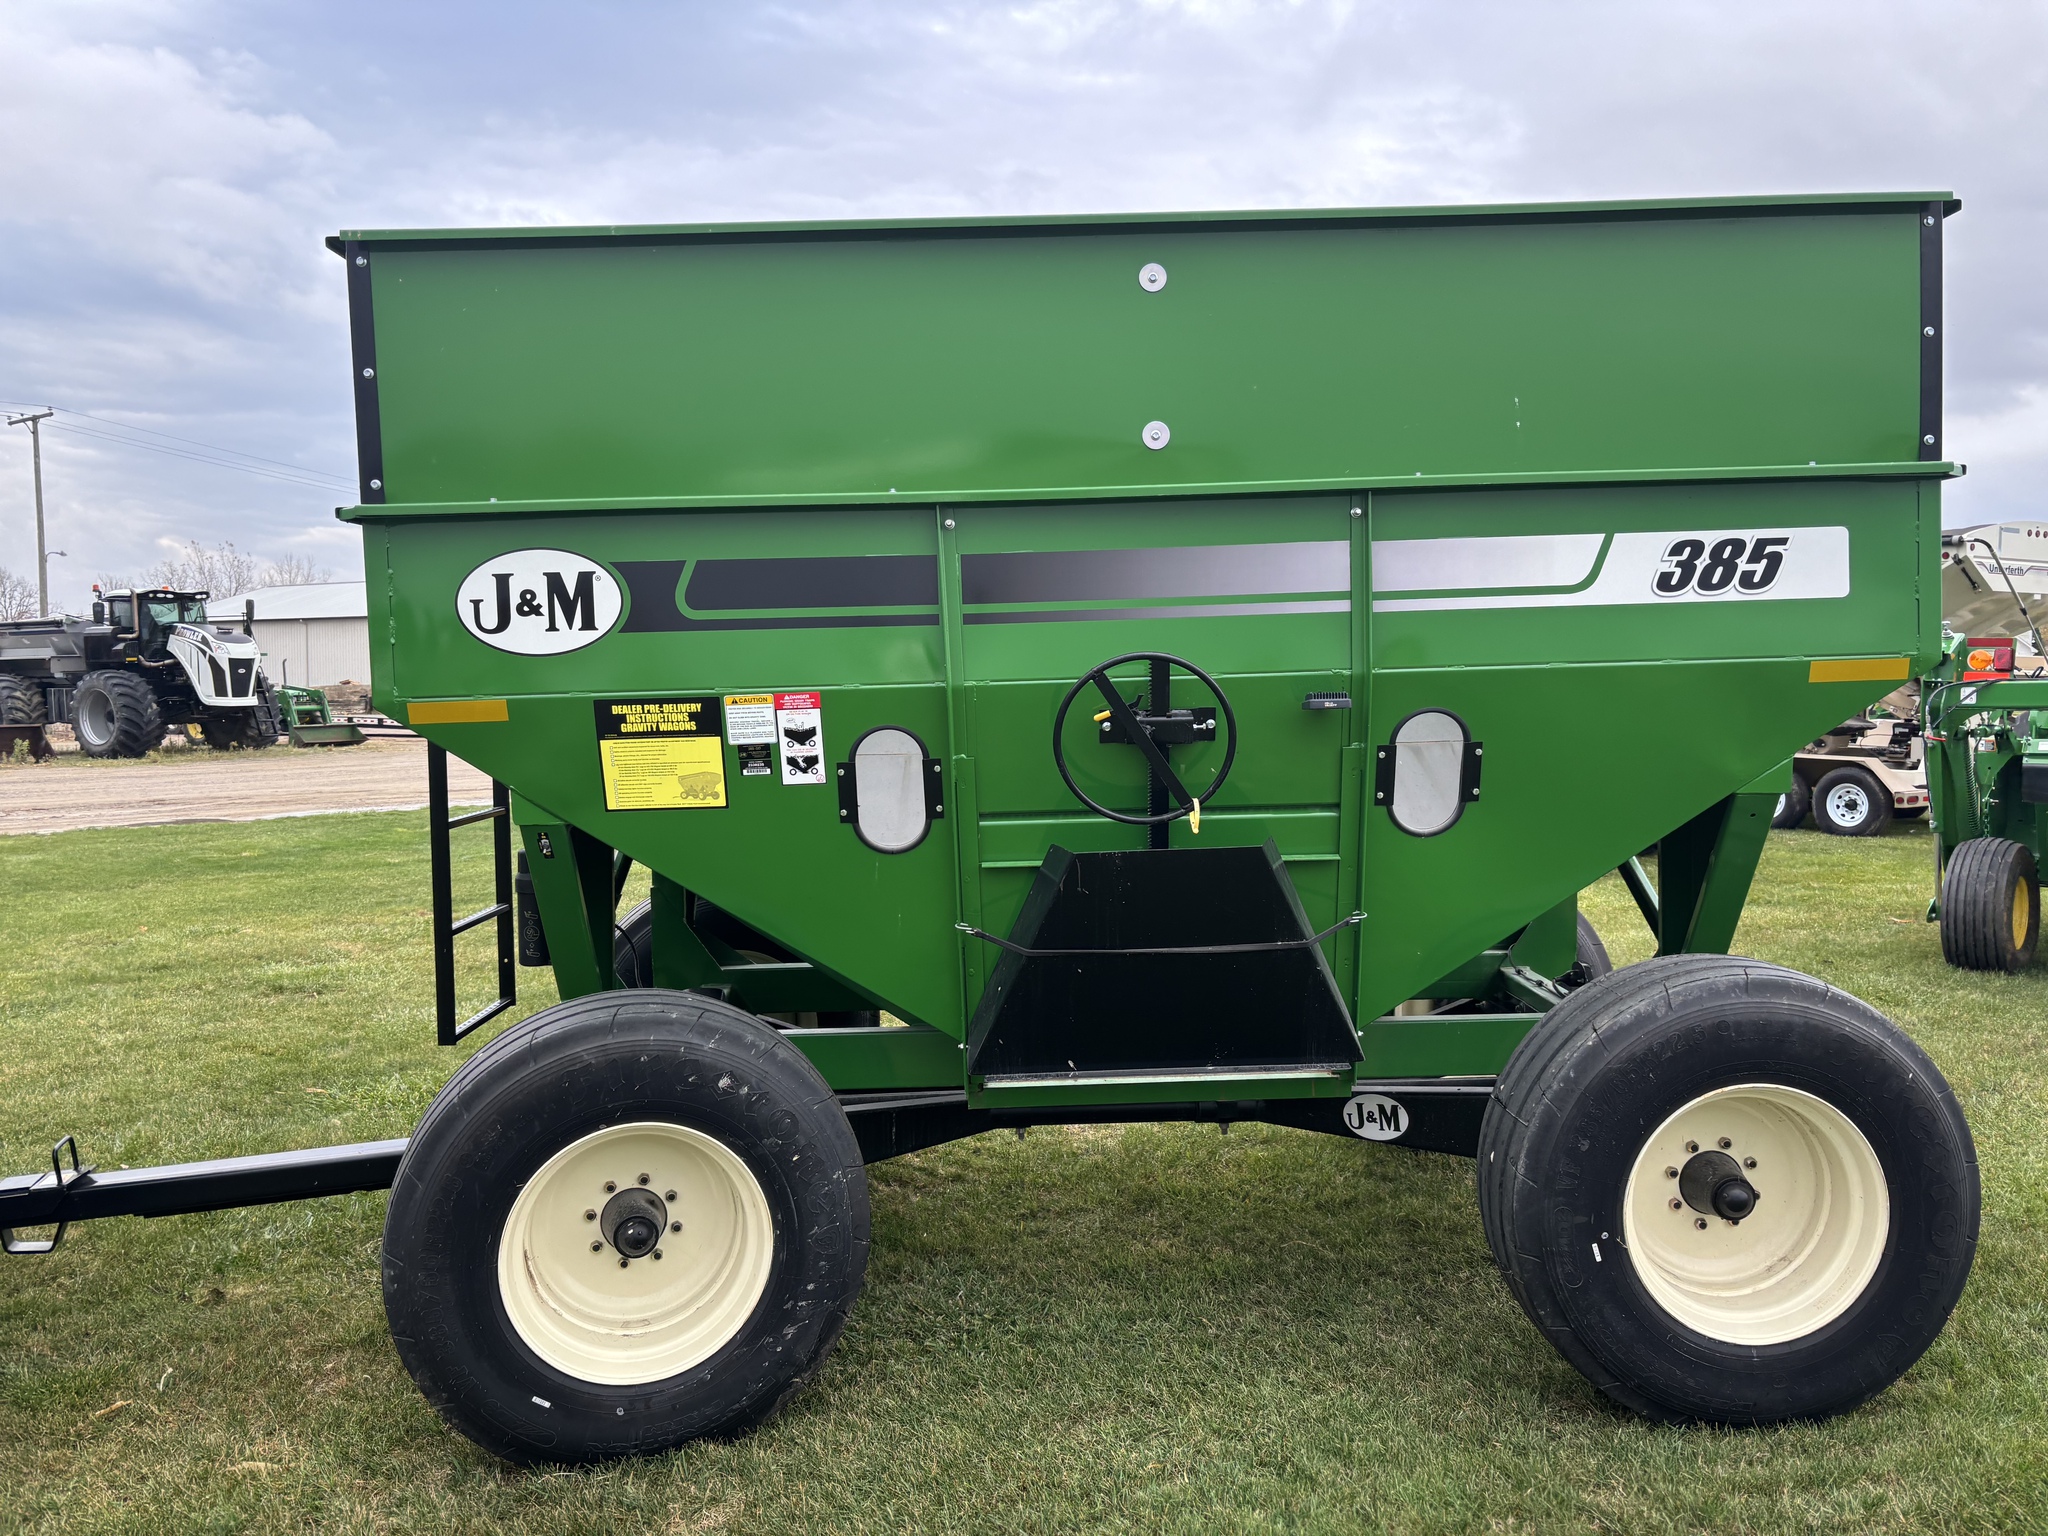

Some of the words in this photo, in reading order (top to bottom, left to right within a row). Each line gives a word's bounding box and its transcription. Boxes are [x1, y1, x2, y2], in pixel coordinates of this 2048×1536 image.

[1654, 535, 1792, 595] 385
[1989, 563, 2024, 575] Unrferth
[469, 571, 599, 634] J&M
[738, 696, 768, 704] CAUTION
[611, 705, 643, 714] DEALER
[644, 703, 702, 713] PRE-DELIVERY
[626, 713, 690, 723] INSTRUCTIONS
[620, 722, 657, 733] GRAVITY
[658, 721, 697, 731] WAGONS
[1346, 1102, 1402, 1132] J&M
